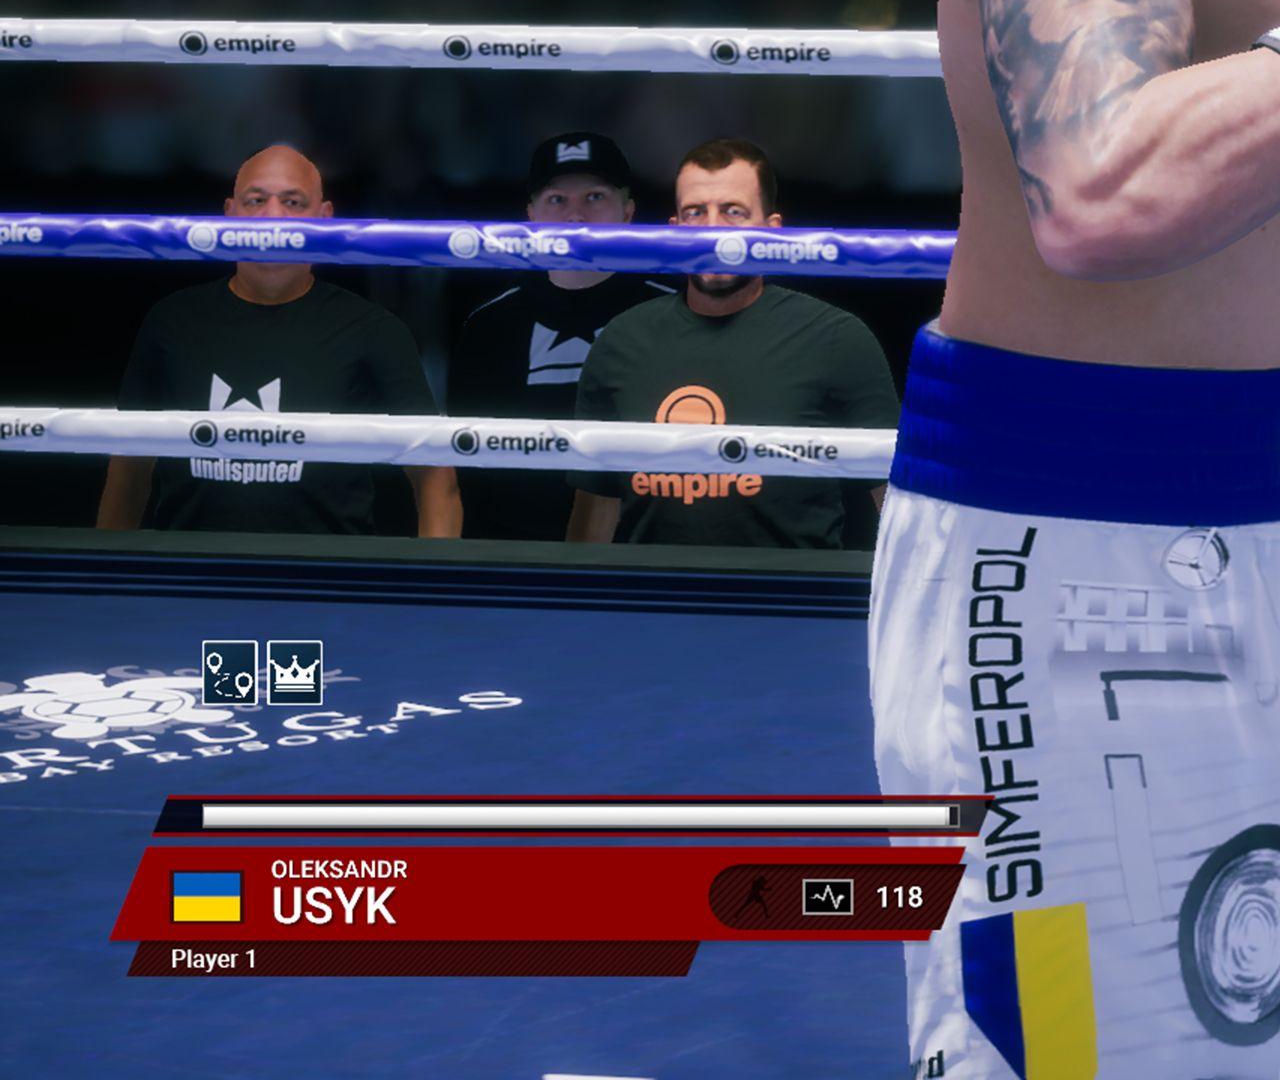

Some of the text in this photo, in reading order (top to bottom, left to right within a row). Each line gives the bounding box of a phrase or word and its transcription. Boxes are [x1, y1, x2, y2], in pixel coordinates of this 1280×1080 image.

[0, 31, 32, 49] ire
[214, 35, 295, 55] empire
[478, 39, 561, 59] empire
[747, 43, 830, 63] empire
[0, 225, 42, 246] pire
[221, 228, 304, 251] empire
[484, 234, 568, 257] empire
[751, 239, 837, 263] empire
[0, 421, 44, 441] pire
[224, 426, 305, 446] empire
[486, 432, 569, 454] empire
[755, 440, 838, 462] empire
[632, 472, 762, 505] empire
[968, 526, 1044, 904] SIMFEROPOL
[0, 690, 522, 769] RTUGAS
[147, 722, 399, 764] RESORT
